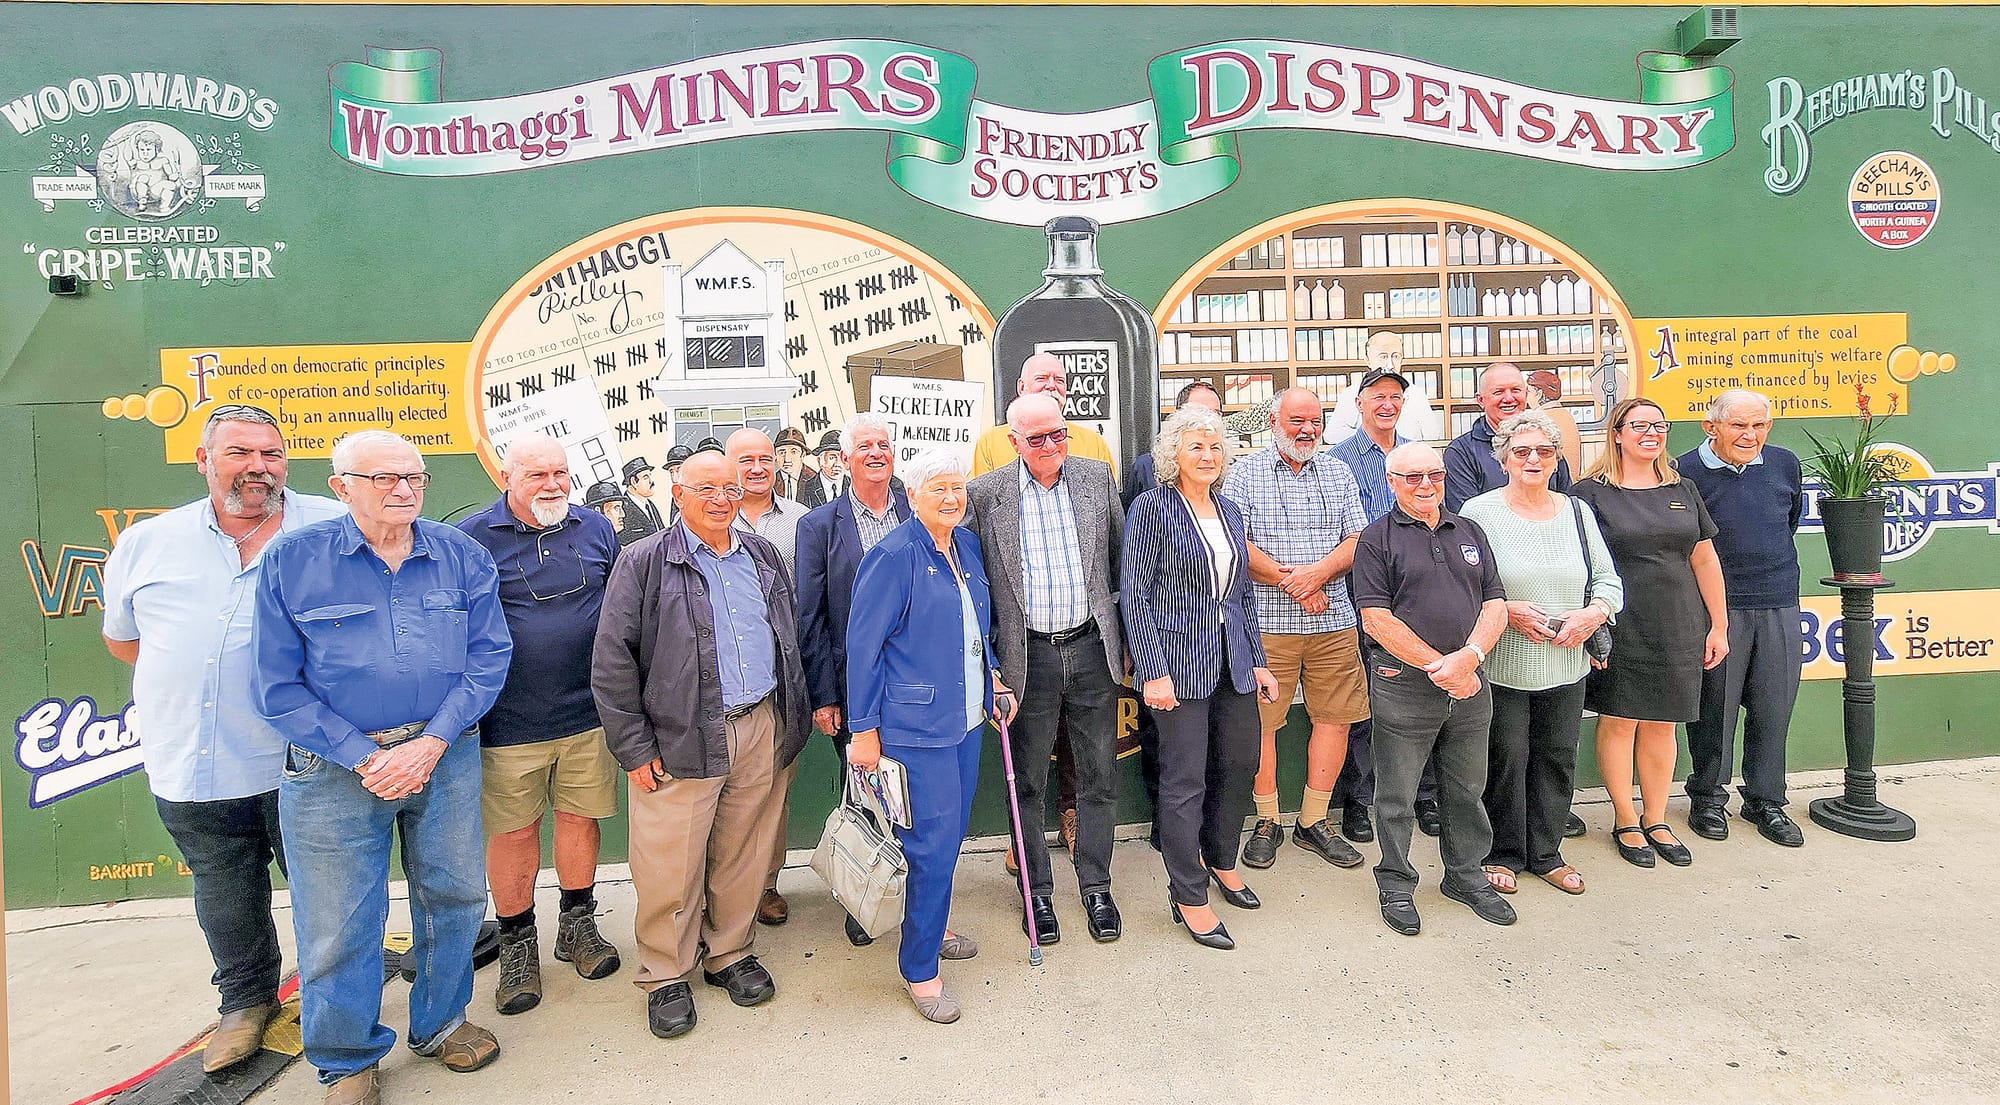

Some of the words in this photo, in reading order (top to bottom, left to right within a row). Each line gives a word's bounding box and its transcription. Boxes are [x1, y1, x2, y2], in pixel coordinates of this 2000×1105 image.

[0, 72, 278, 136] WOODWARD'S
[340, 95, 595, 168] Wonthaggi
[609, 54, 940, 143] MINERS
[1182, 51, 1714, 156] DISPENSARY
[975, 116, 1149, 164] FRIENDLY
[209, 182, 235, 190] TRADE
[237, 181, 262, 189] MARK
[970, 157, 1159, 205] SOCIETY'S
[1857, 159, 1931, 193] BEECHAM'S
[1875, 182, 1914, 196] PILLS
[1860, 203, 1893, 211] SMOOTH
[1895, 202, 1928, 210] COATED
[1895, 217, 1926, 225] GUINEA
[85, 227, 219, 243] CELEBRATED
[1881, 231, 1889, 239] A
[1891, 231, 1908, 239] BOX
[696, 277, 755, 290] W.M.F.S.
[696, 323, 749, 333] DISPENSARY
[1685, 327, 1736, 345] integral
[1743, 328, 1770, 347] part
[1776, 325, 1790, 340] of
[1797, 326, 1819, 339] the
[1829, 325, 1858, 339] coal
[1687, 350, 1734, 367] mining
[1740, 348, 1824, 368] community's
[1830, 348, 1882, 362] welfare
[189, 352, 268, 409] Founded
[271, 365, 288, 374] on
[292, 359, 367, 374] democratic
[375, 356, 445, 378] principles
[1066, 375, 1105, 395] LACK
[1746, 371, 1806, 387] financed
[1813, 368, 1829, 391] by
[1837, 370, 1877, 386] levies
[228, 387, 243, 400] of
[247, 384, 337, 404] co-operation
[342, 382, 370, 398] and
[878, 395, 975, 417] SECRETARY
[1063, 397, 1102, 416] ACK
[1769, 396, 1833, 416] iptions.
[280, 408, 298, 429] by
[304, 412, 322, 423] an
[328, 408, 393, 428] annually
[399, 406, 447, 422] elected
[903, 426, 951, 442] McKENZIE
[1906, 609, 1929, 633] is
[1906, 636, 1993, 659] Better
